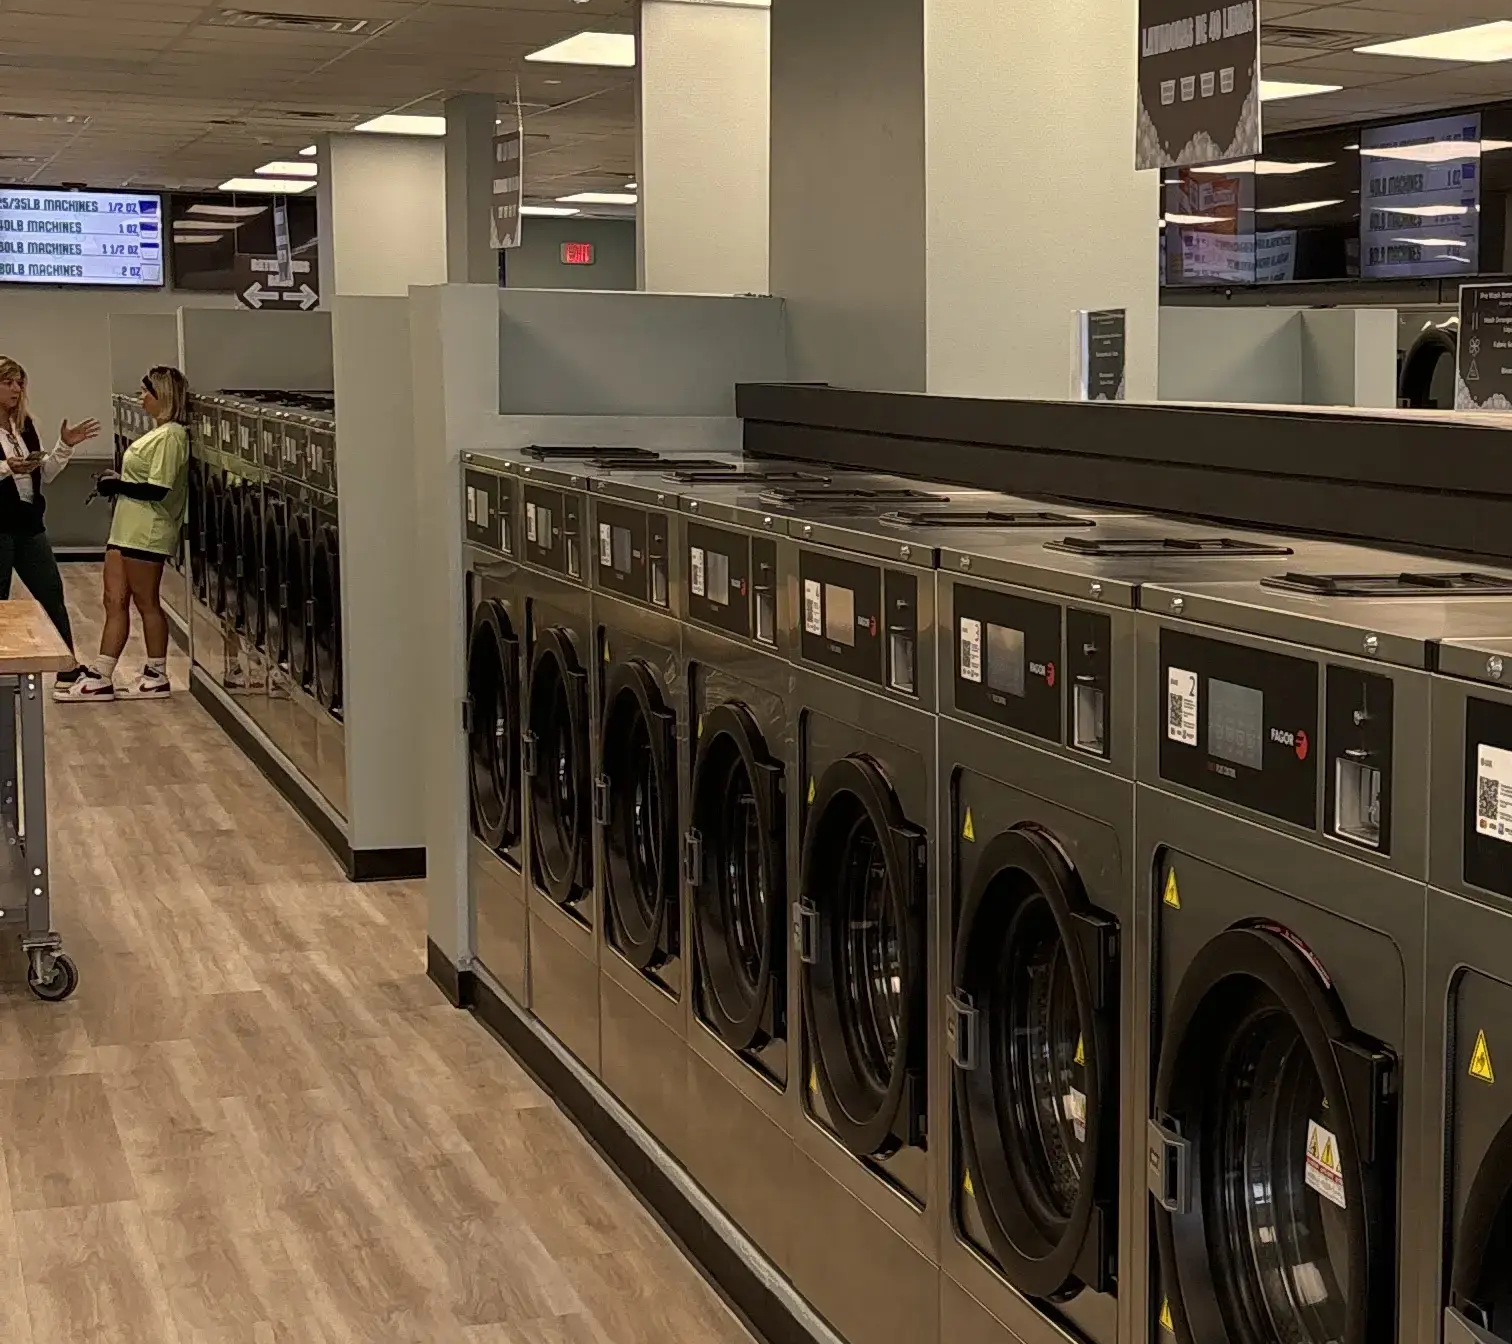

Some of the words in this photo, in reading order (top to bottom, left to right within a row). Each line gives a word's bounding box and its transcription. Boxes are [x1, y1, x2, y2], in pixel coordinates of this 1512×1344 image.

[44, 199, 98, 212] MACHINES
[28, 220, 82, 233] MACHINES
[28, 242, 82, 255] MACHINES
[566, 242, 591, 264] EXIT
[28, 264, 83, 276] MACHINES
[1189, 676, 1195, 697] 2
[1270, 728, 1294, 746] FAGOR
